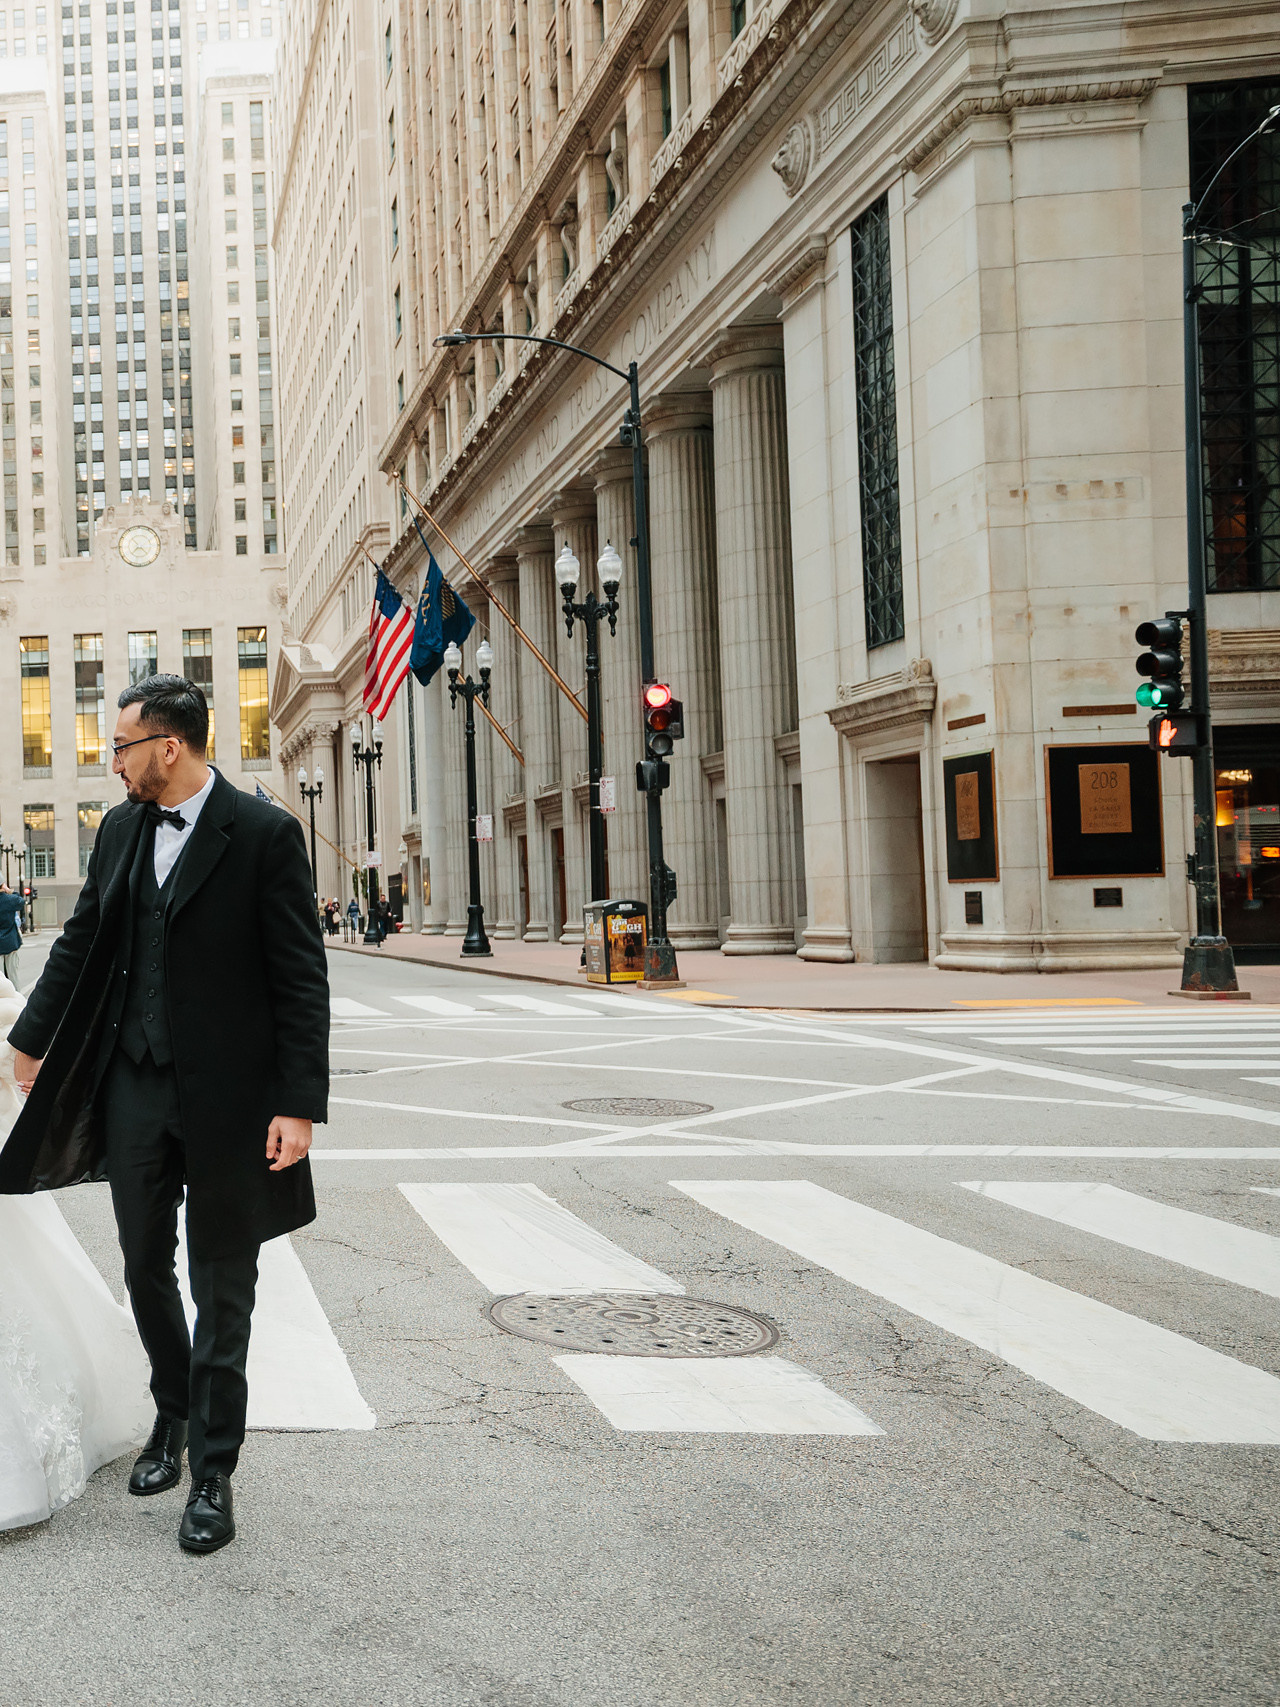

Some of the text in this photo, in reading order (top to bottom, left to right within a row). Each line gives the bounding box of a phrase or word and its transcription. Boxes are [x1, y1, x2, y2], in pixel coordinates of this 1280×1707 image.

[501, 448, 528, 506] BANK
[535, 415, 559, 470] AND
[568, 352, 611, 431] TRUST
[622, 228, 714, 371] COMPANY
[30, 587, 256, 610] CHICAGO BOARD OF TRADE
[1090, 771, 1118, 790] 208
